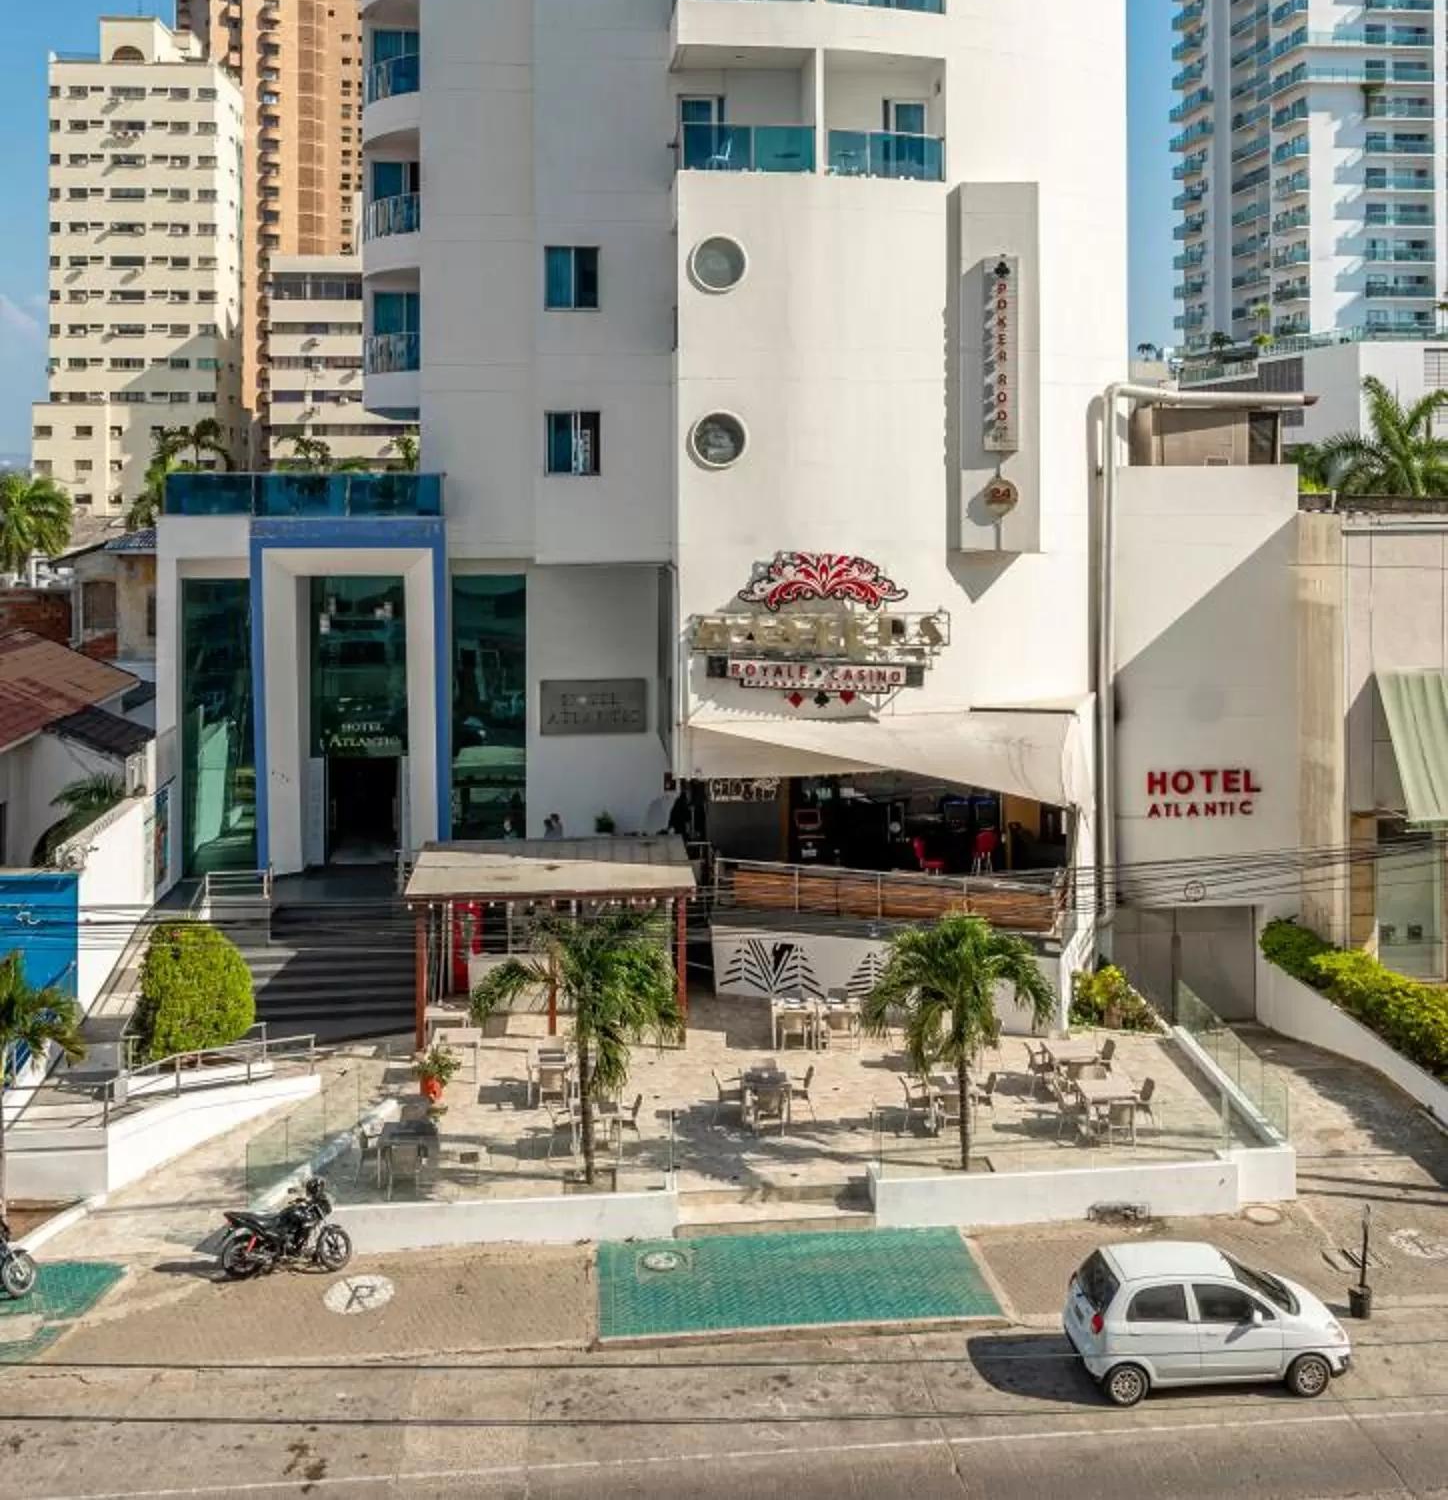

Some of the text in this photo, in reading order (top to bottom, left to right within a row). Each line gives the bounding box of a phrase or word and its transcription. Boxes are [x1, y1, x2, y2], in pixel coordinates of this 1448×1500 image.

[996, 283, 1008, 362] POKER
[730, 662, 901, 683] ROYALE CASINO
[341, 721, 385, 734] HOTEL
[1147, 768, 1262, 796] HOTEL
[1147, 800, 1254, 819] ATLANTIC
